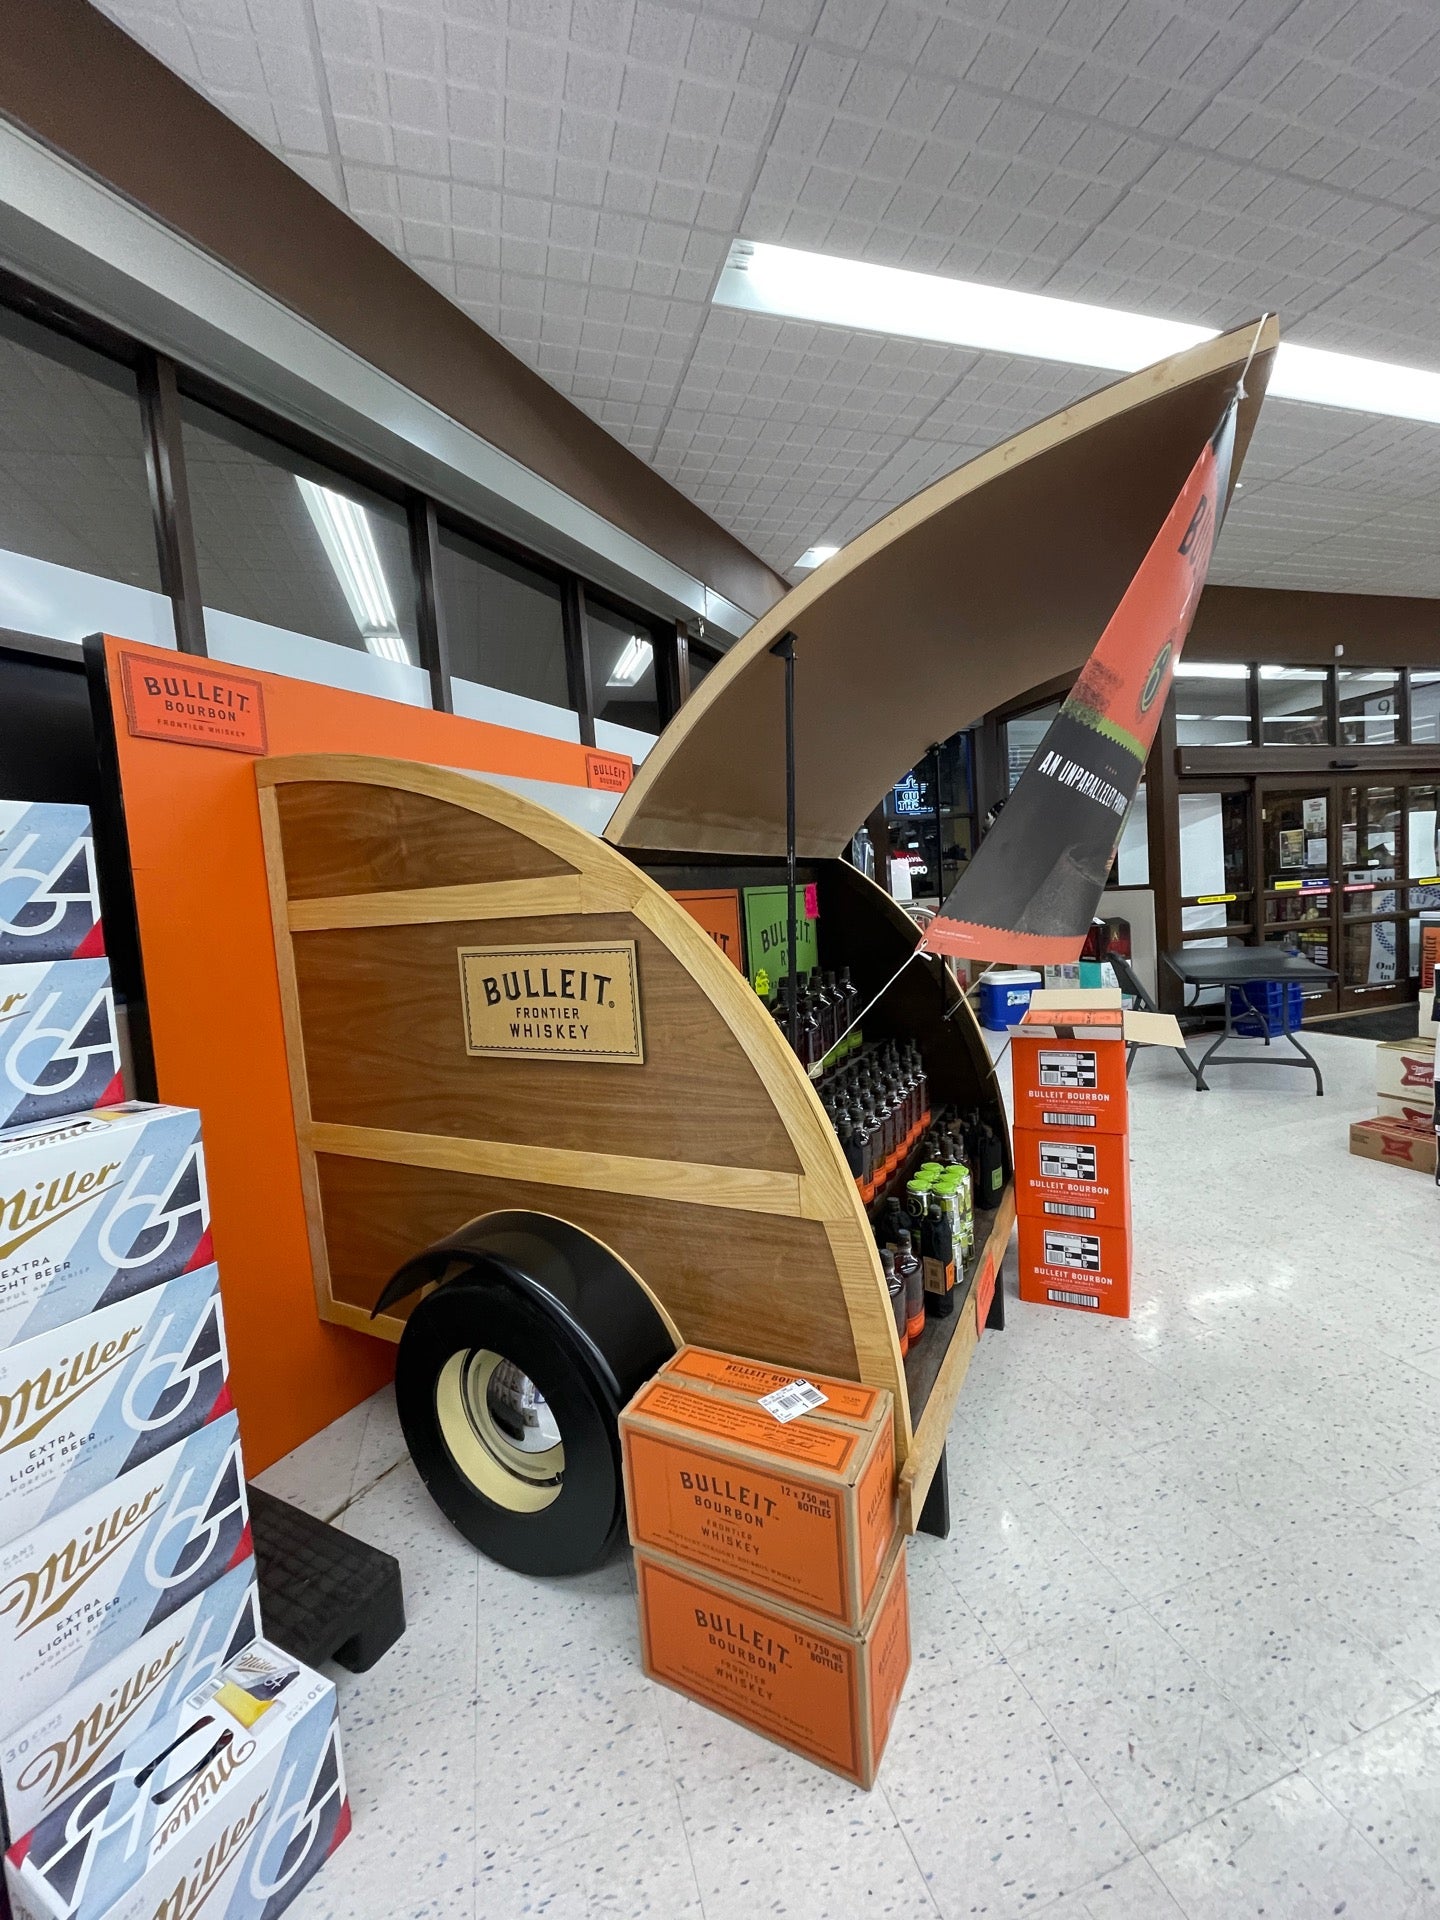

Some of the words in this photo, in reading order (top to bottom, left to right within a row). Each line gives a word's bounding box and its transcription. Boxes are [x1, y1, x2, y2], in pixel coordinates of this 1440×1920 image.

[144, 677, 249, 712] BULLEIT
[165, 700, 236, 721] BOURBON
[157, 719, 204, 731] FRONTIER
[208, 726, 245, 737] WHISKEY
[593, 764, 626, 780] BULLEIT
[1038, 751, 1062, 777] AN
[516, 1007, 579, 1019] FRONTIER
[5, 987, 121, 1095] 64
[510, 1023, 588, 1039] WHISKEY
[1028, 1090, 1064, 1099] BULLEIT
[1067, 1092, 1110, 1101] BOURBON
[1029, 1179, 1064, 1190] BULLEIT
[1067, 1183, 1109, 1196] BOURBON
[98, 1142, 211, 1268] 64
[2, 1257, 50, 1279] EXTRA
[35, 1261, 71, 1280] BEER
[1034, 1267, 1069, 1279] BULLEIT
[1071, 1272, 1113, 1285] BOURBON
[122, 1292, 229, 1431] 64
[726, 1364, 768, 1378] BULLEIT
[10, 1453, 55, 1483] LIGHT
[61, 1432, 95, 1455] BEER
[29, 1431, 75, 1459] EXTRA
[680, 1471, 777, 1517] BULLEIT
[781, 1485, 791, 1497] 12
[801, 1491, 817, 1505] 750
[694, 1495, 763, 1528] BOURBON
[797, 1501, 832, 1519] BOTTLES
[0, 1484, 164, 1628] Miller
[145, 1439, 250, 1589] 64
[701, 1526, 760, 1556] WHISKEY
[706, 1518, 753, 1540] FRONTIER
[38, 1622, 81, 1657] LIGHT
[87, 1597, 120, 1623] BEER
[56, 1598, 101, 1631] EXTRA
[695, 1608, 790, 1665] BULLEIT
[794, 1633, 803, 1646] 12
[813, 1642, 829, 1658] 750
[241, 1652, 277, 1671] Miller
[709, 1633, 777, 1675] BOURBON
[810, 1651, 844, 1674] BOTTLES
[716, 1667, 773, 1700] WHISKEY
[721, 1658, 766, 1685] FRONTIER
[16, 1636, 185, 1799] Miller
[5, 1739, 29, 1763] 30
[153, 1739, 256, 1856] Miller
[250, 1716, 347, 1900] 64
